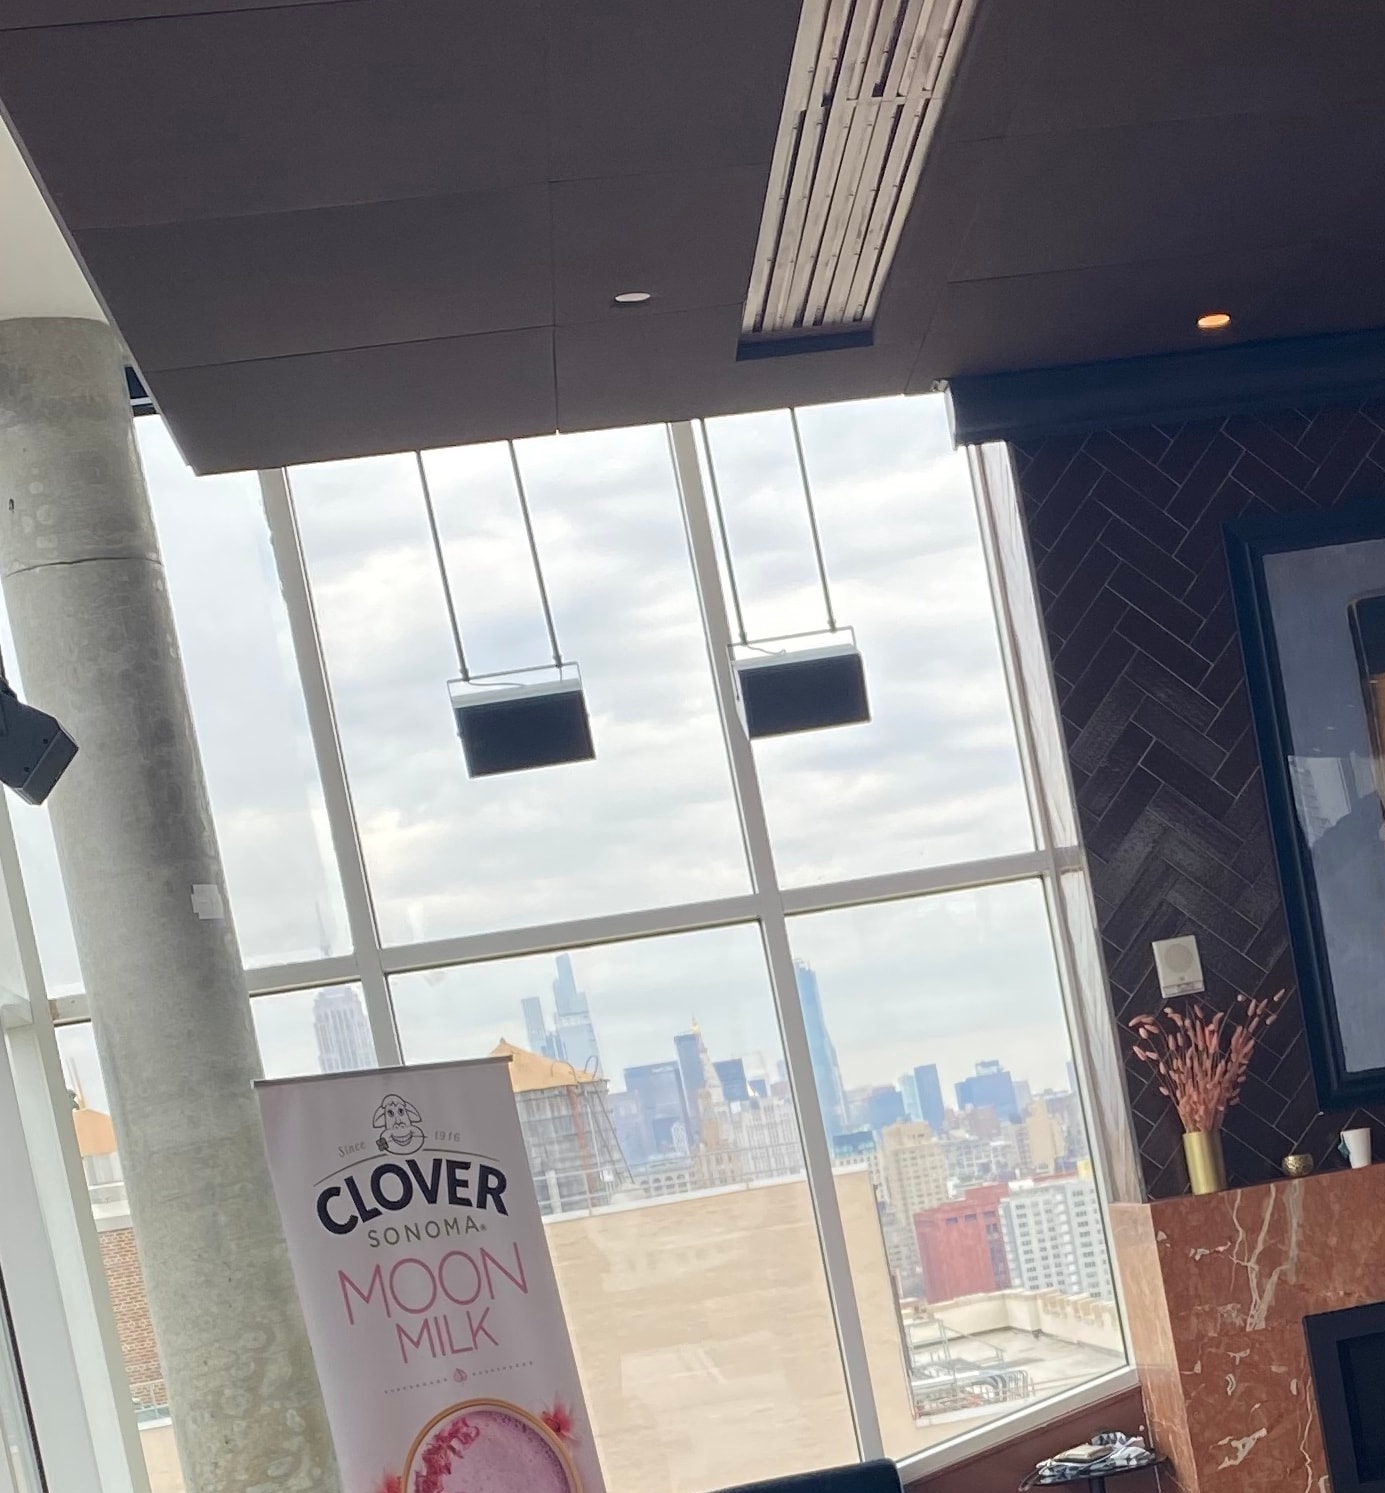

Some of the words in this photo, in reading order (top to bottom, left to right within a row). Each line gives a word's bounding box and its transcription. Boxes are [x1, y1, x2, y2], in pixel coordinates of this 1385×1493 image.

[337, 1141, 366, 1158] Since
[434, 1130, 461, 1143] 1916
[316, 1158, 509, 1236] CLOVER
[367, 1215, 480, 1248] SONOMA
[337, 1241, 529, 1326] MOON
[396, 1306, 499, 1364] MILK
